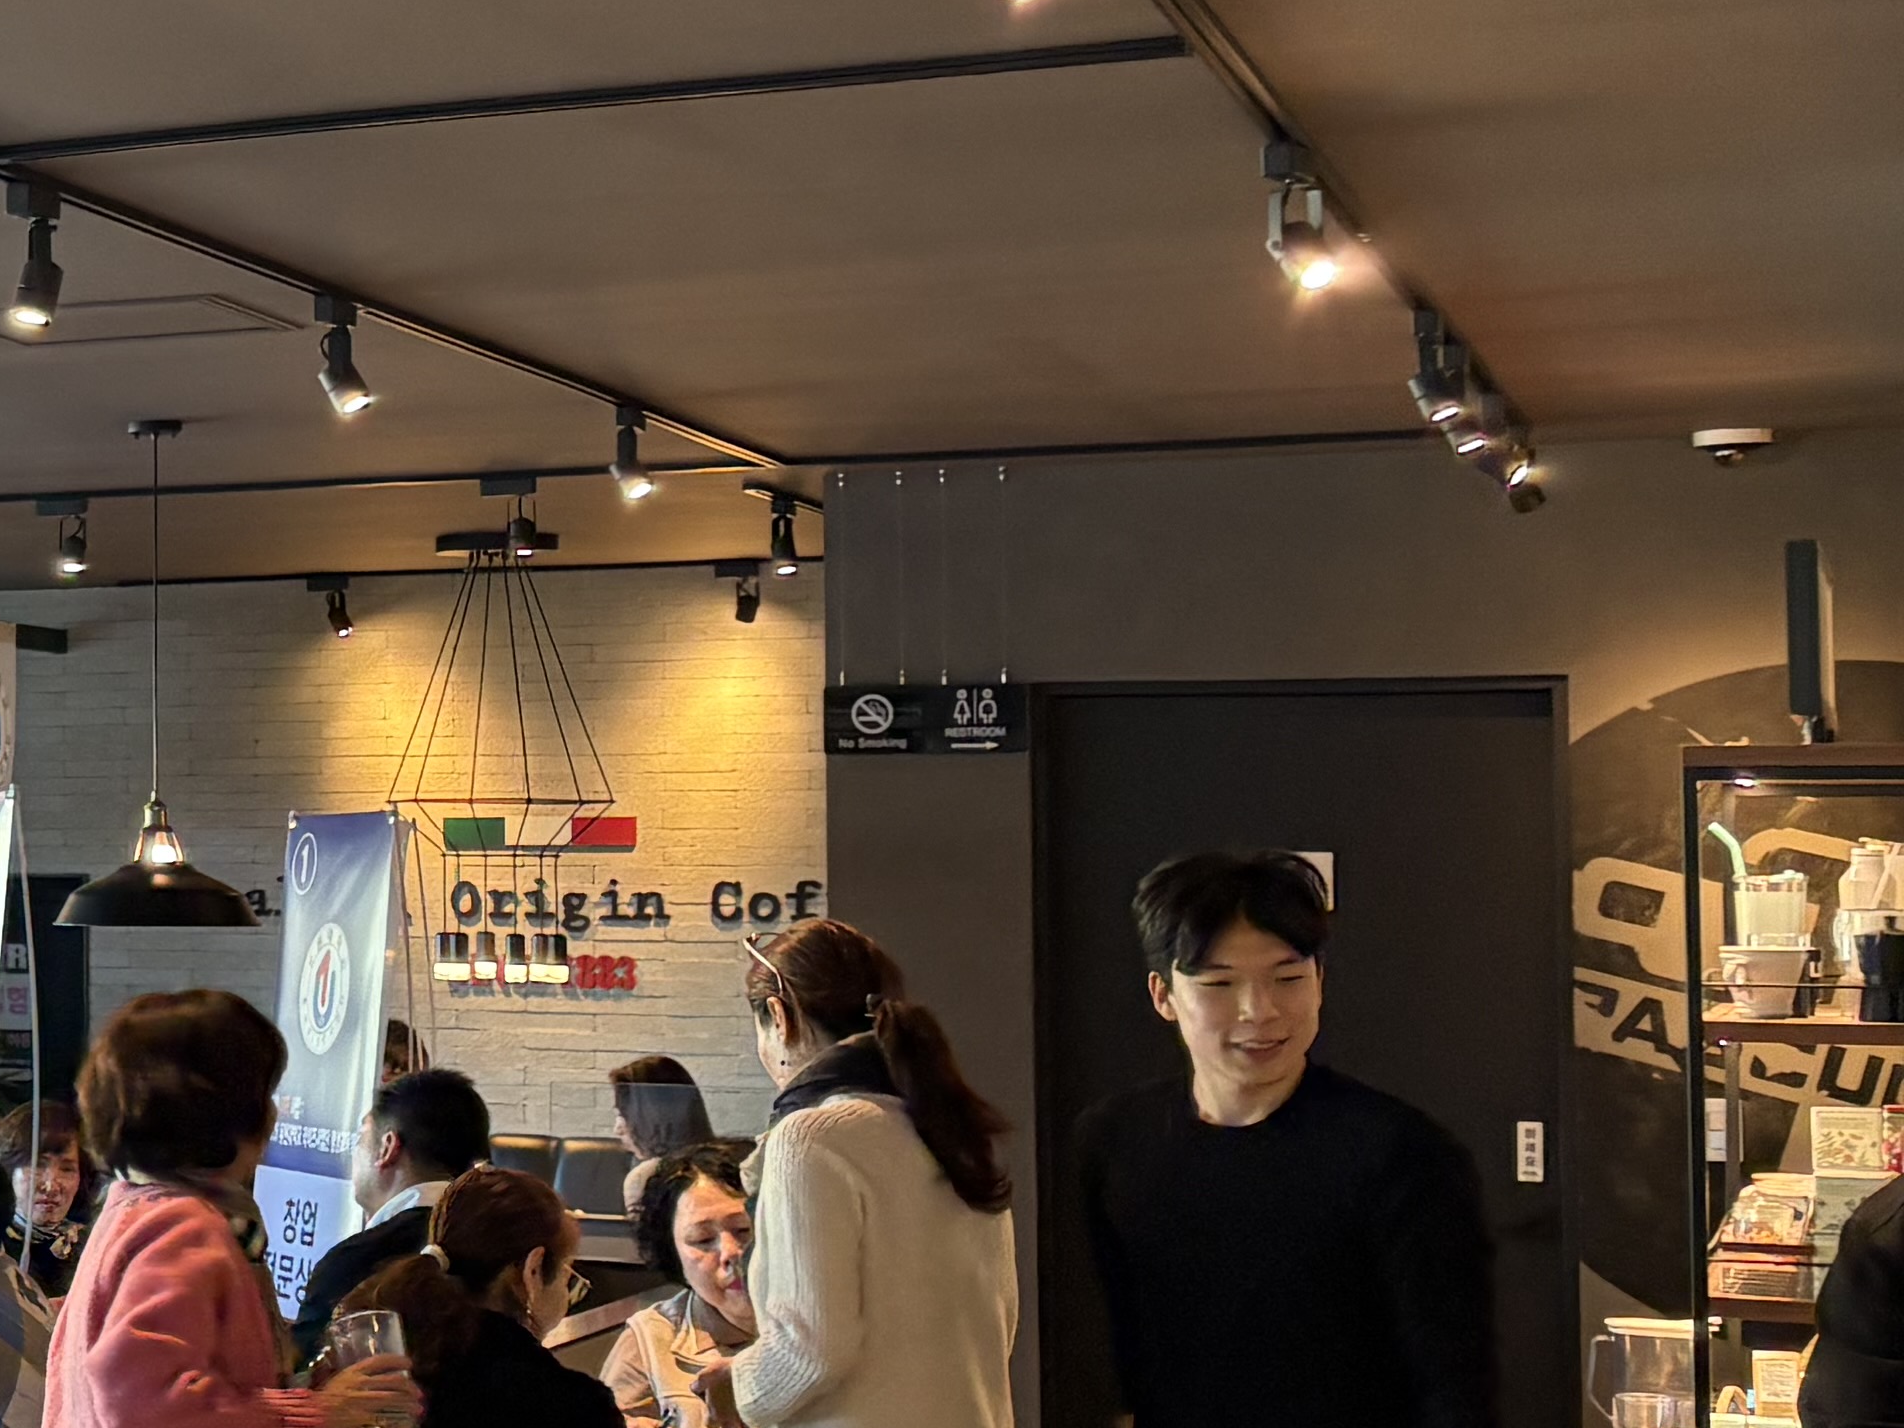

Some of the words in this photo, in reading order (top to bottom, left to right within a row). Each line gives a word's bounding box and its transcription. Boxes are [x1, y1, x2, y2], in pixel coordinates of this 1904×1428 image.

[839, 738, 854, 749] No
[858, 737, 908, 749] Smoking
[945, 727, 1007, 738] RESTROOM
[449, 878, 671, 934] Origin
[283, 1197, 318, 1247] 창업
